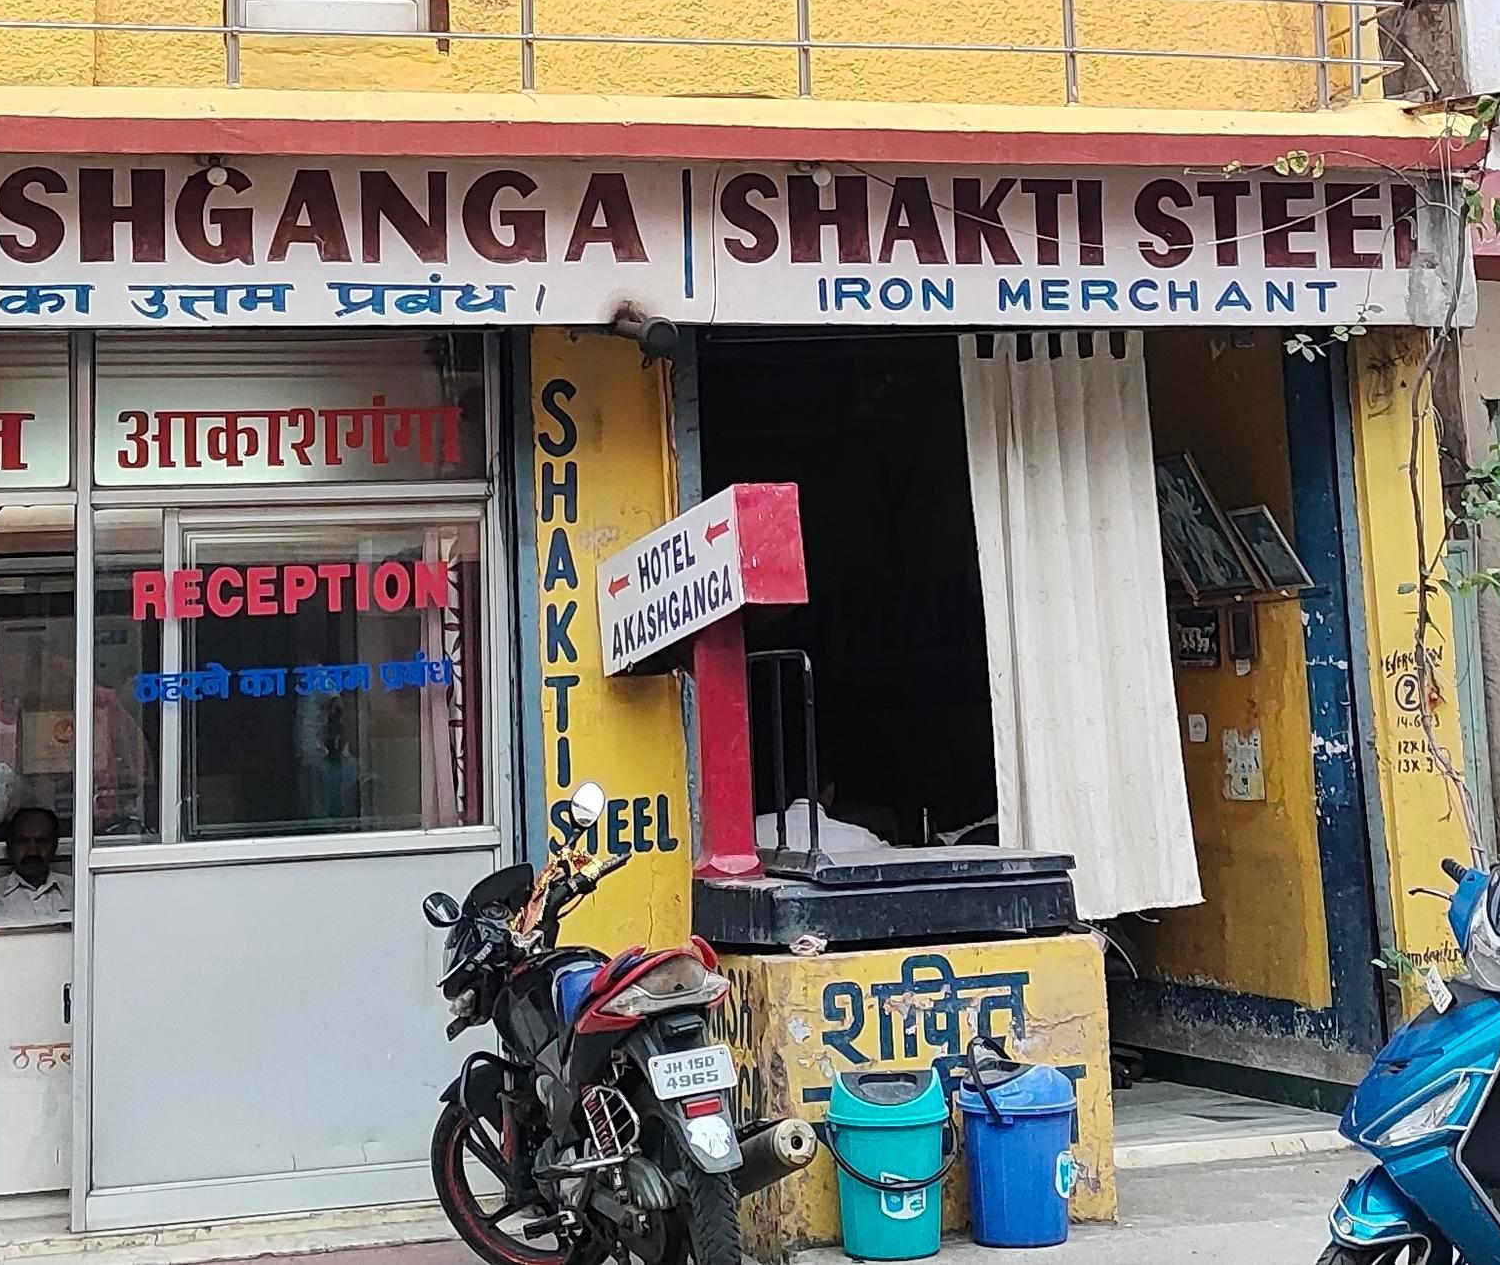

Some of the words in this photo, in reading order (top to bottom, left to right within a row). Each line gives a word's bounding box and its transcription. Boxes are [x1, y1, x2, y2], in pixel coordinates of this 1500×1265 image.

[718, 172, 1106, 268] SHAKTI
[127, 282, 294, 322] उत्तम
[817, 275, 956, 313] IRON
[998, 277, 1339, 315] MERCHANT
[116, 394, 463, 470] आकाशगंगा
[131, 561, 450, 621] RECEPTION
[636, 529, 697, 595] HOTEL
[610, 563, 734, 662] AKASHGANGA
[239, 666, 288, 699] का
[666, 1069, 720, 1090] 4965
